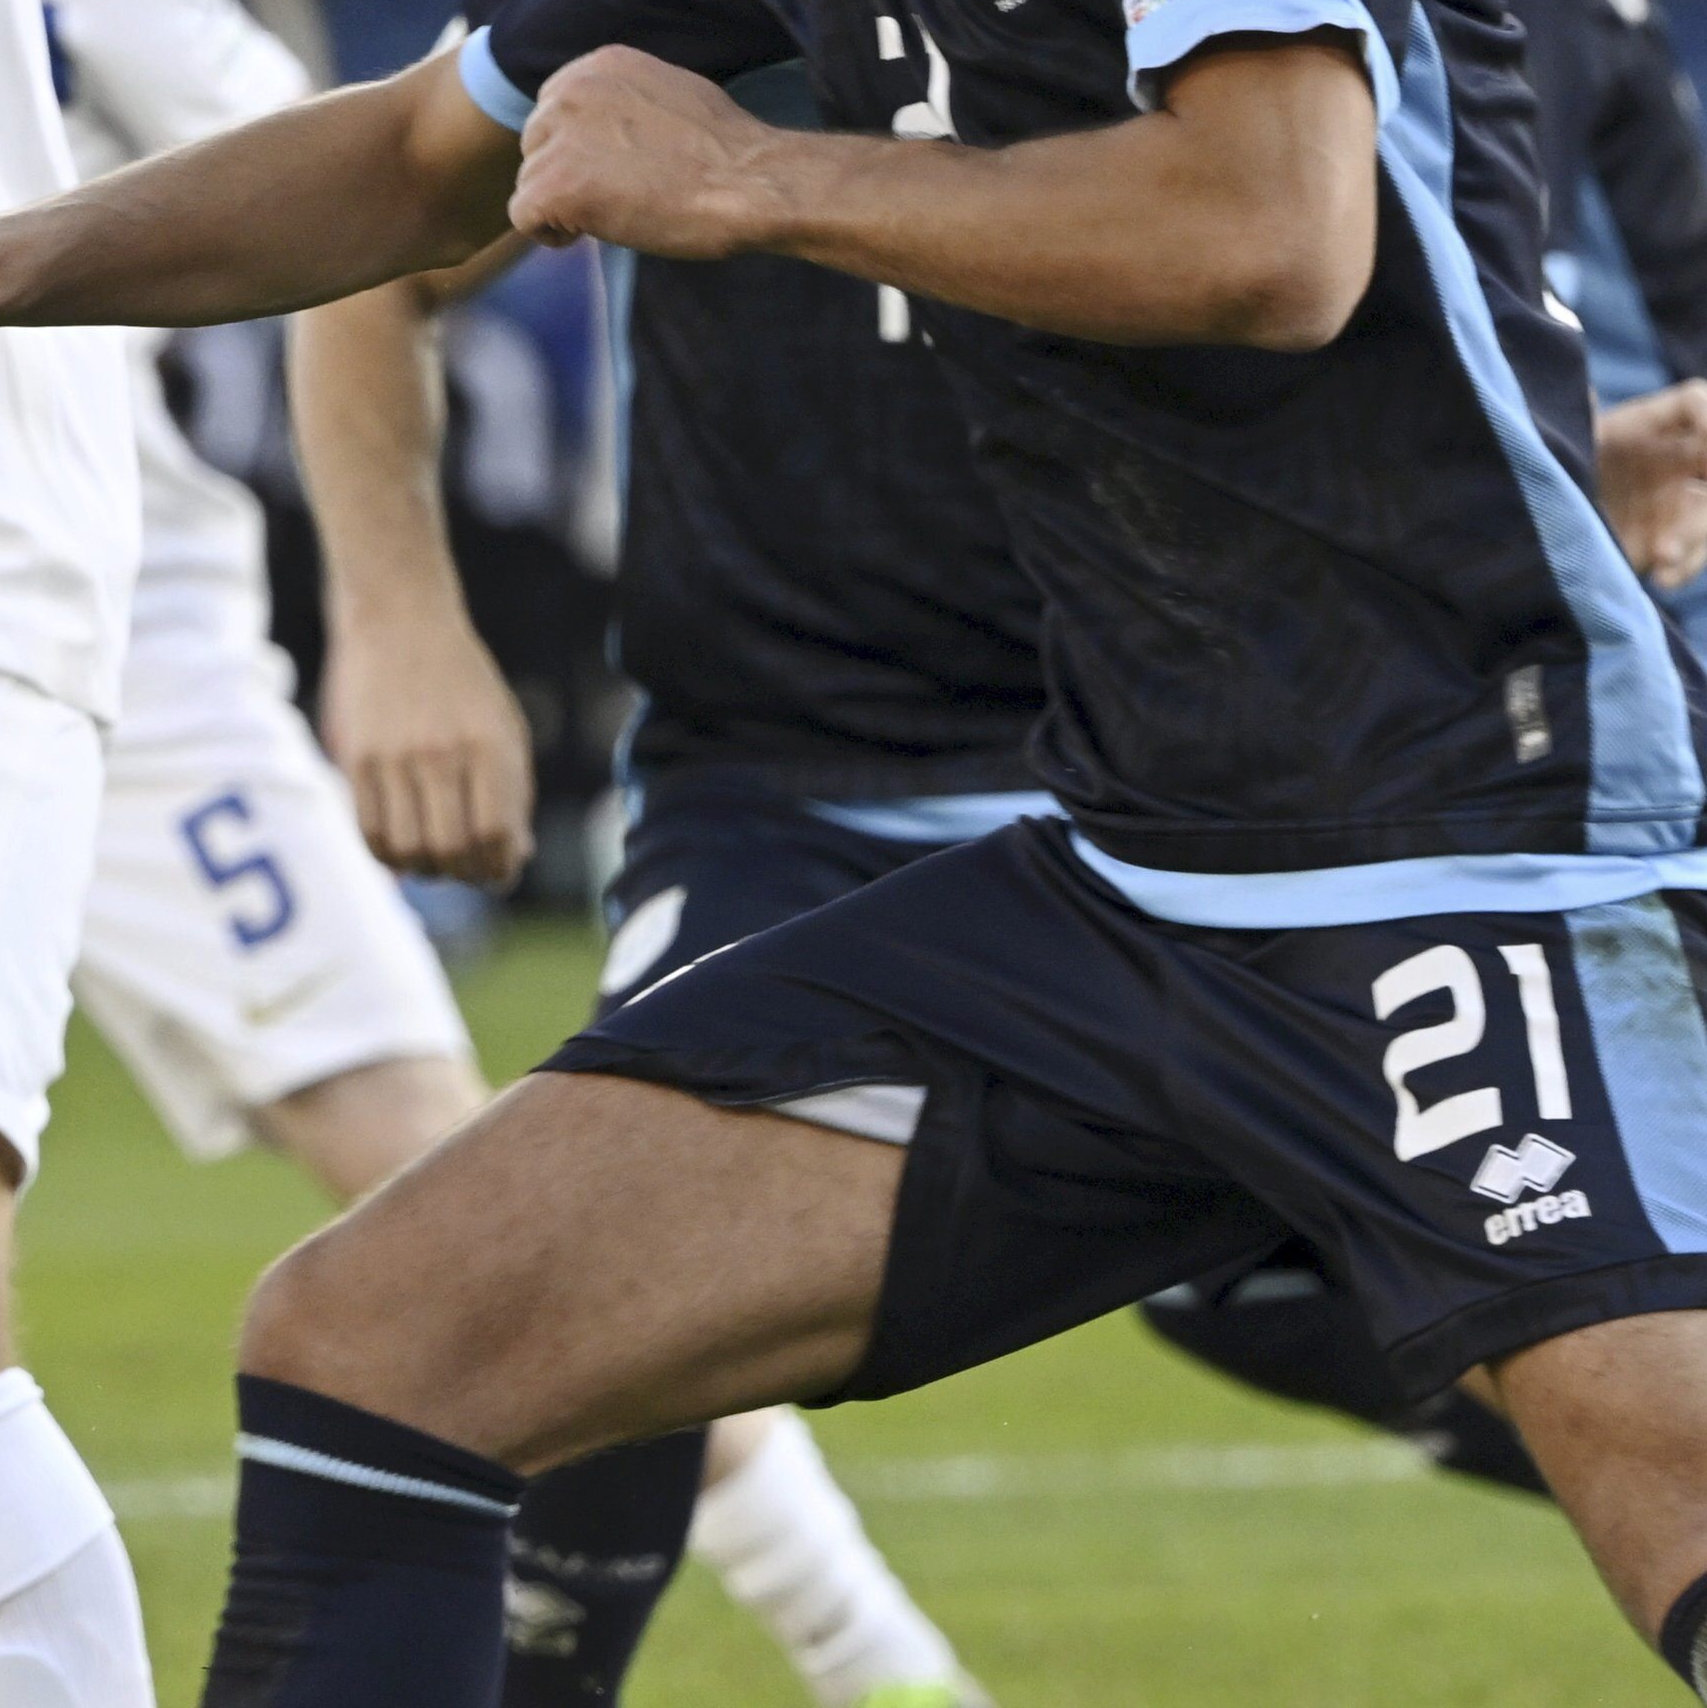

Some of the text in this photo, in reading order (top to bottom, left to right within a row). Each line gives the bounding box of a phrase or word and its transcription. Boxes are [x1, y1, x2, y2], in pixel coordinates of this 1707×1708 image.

[179, 792, 295, 949] 5
[1372, 943, 1573, 1163] 21
[1484, 1190, 1593, 1245] errea
